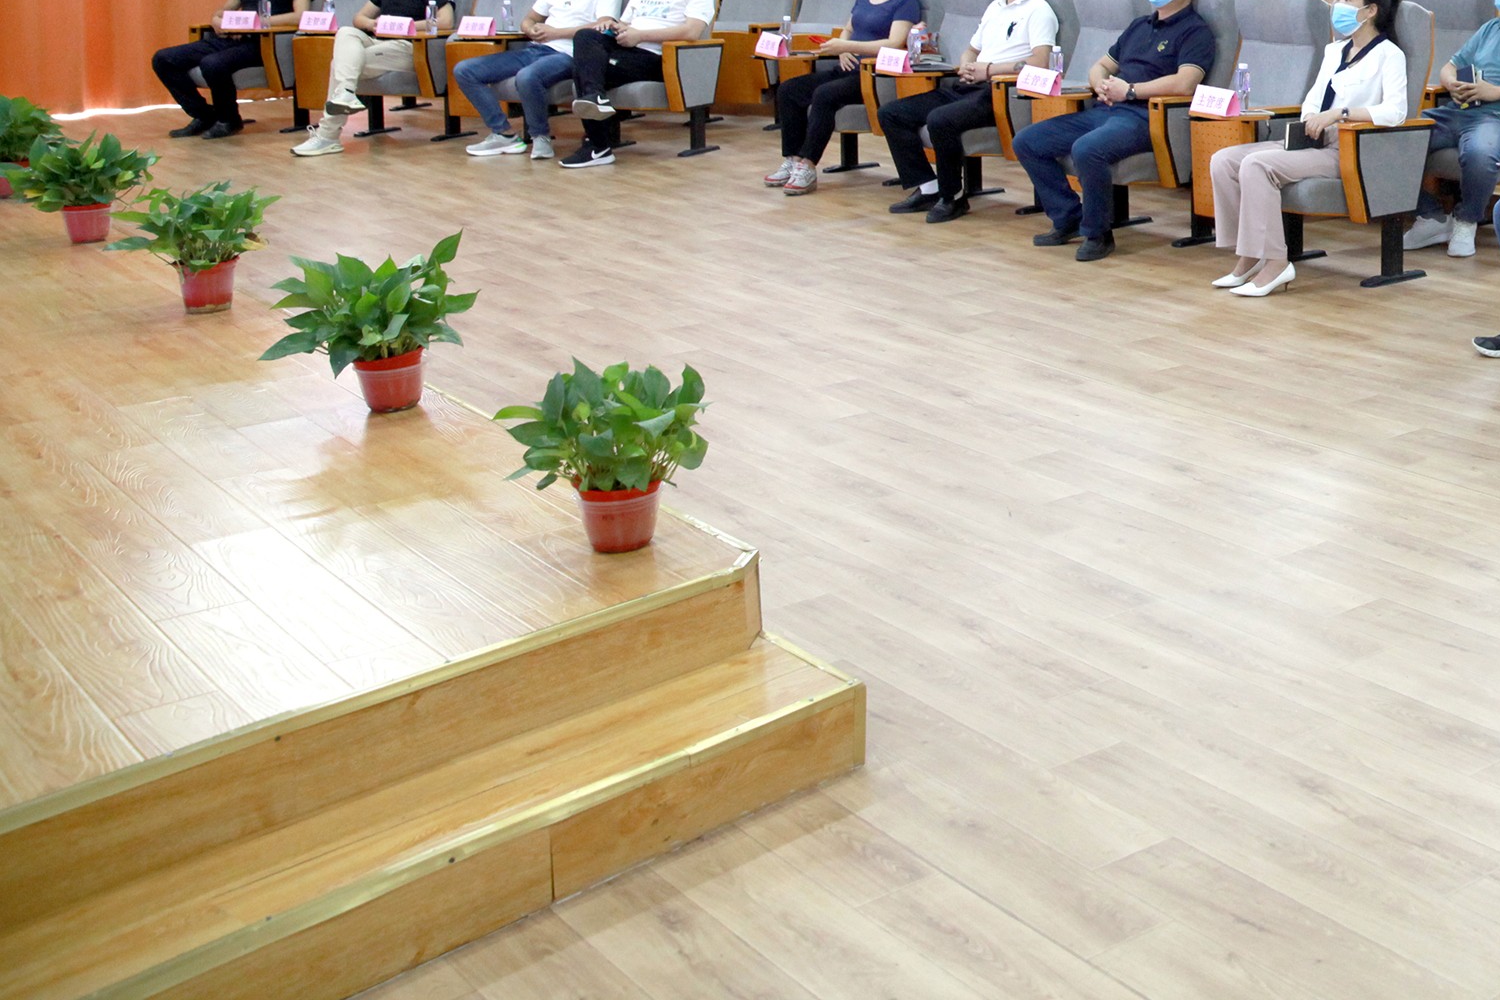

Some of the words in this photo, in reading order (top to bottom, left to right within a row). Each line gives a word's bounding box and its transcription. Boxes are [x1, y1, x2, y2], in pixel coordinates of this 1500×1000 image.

[1021, 72, 1049, 87] 主管席
[1197, 93, 1225, 109] 主管席
